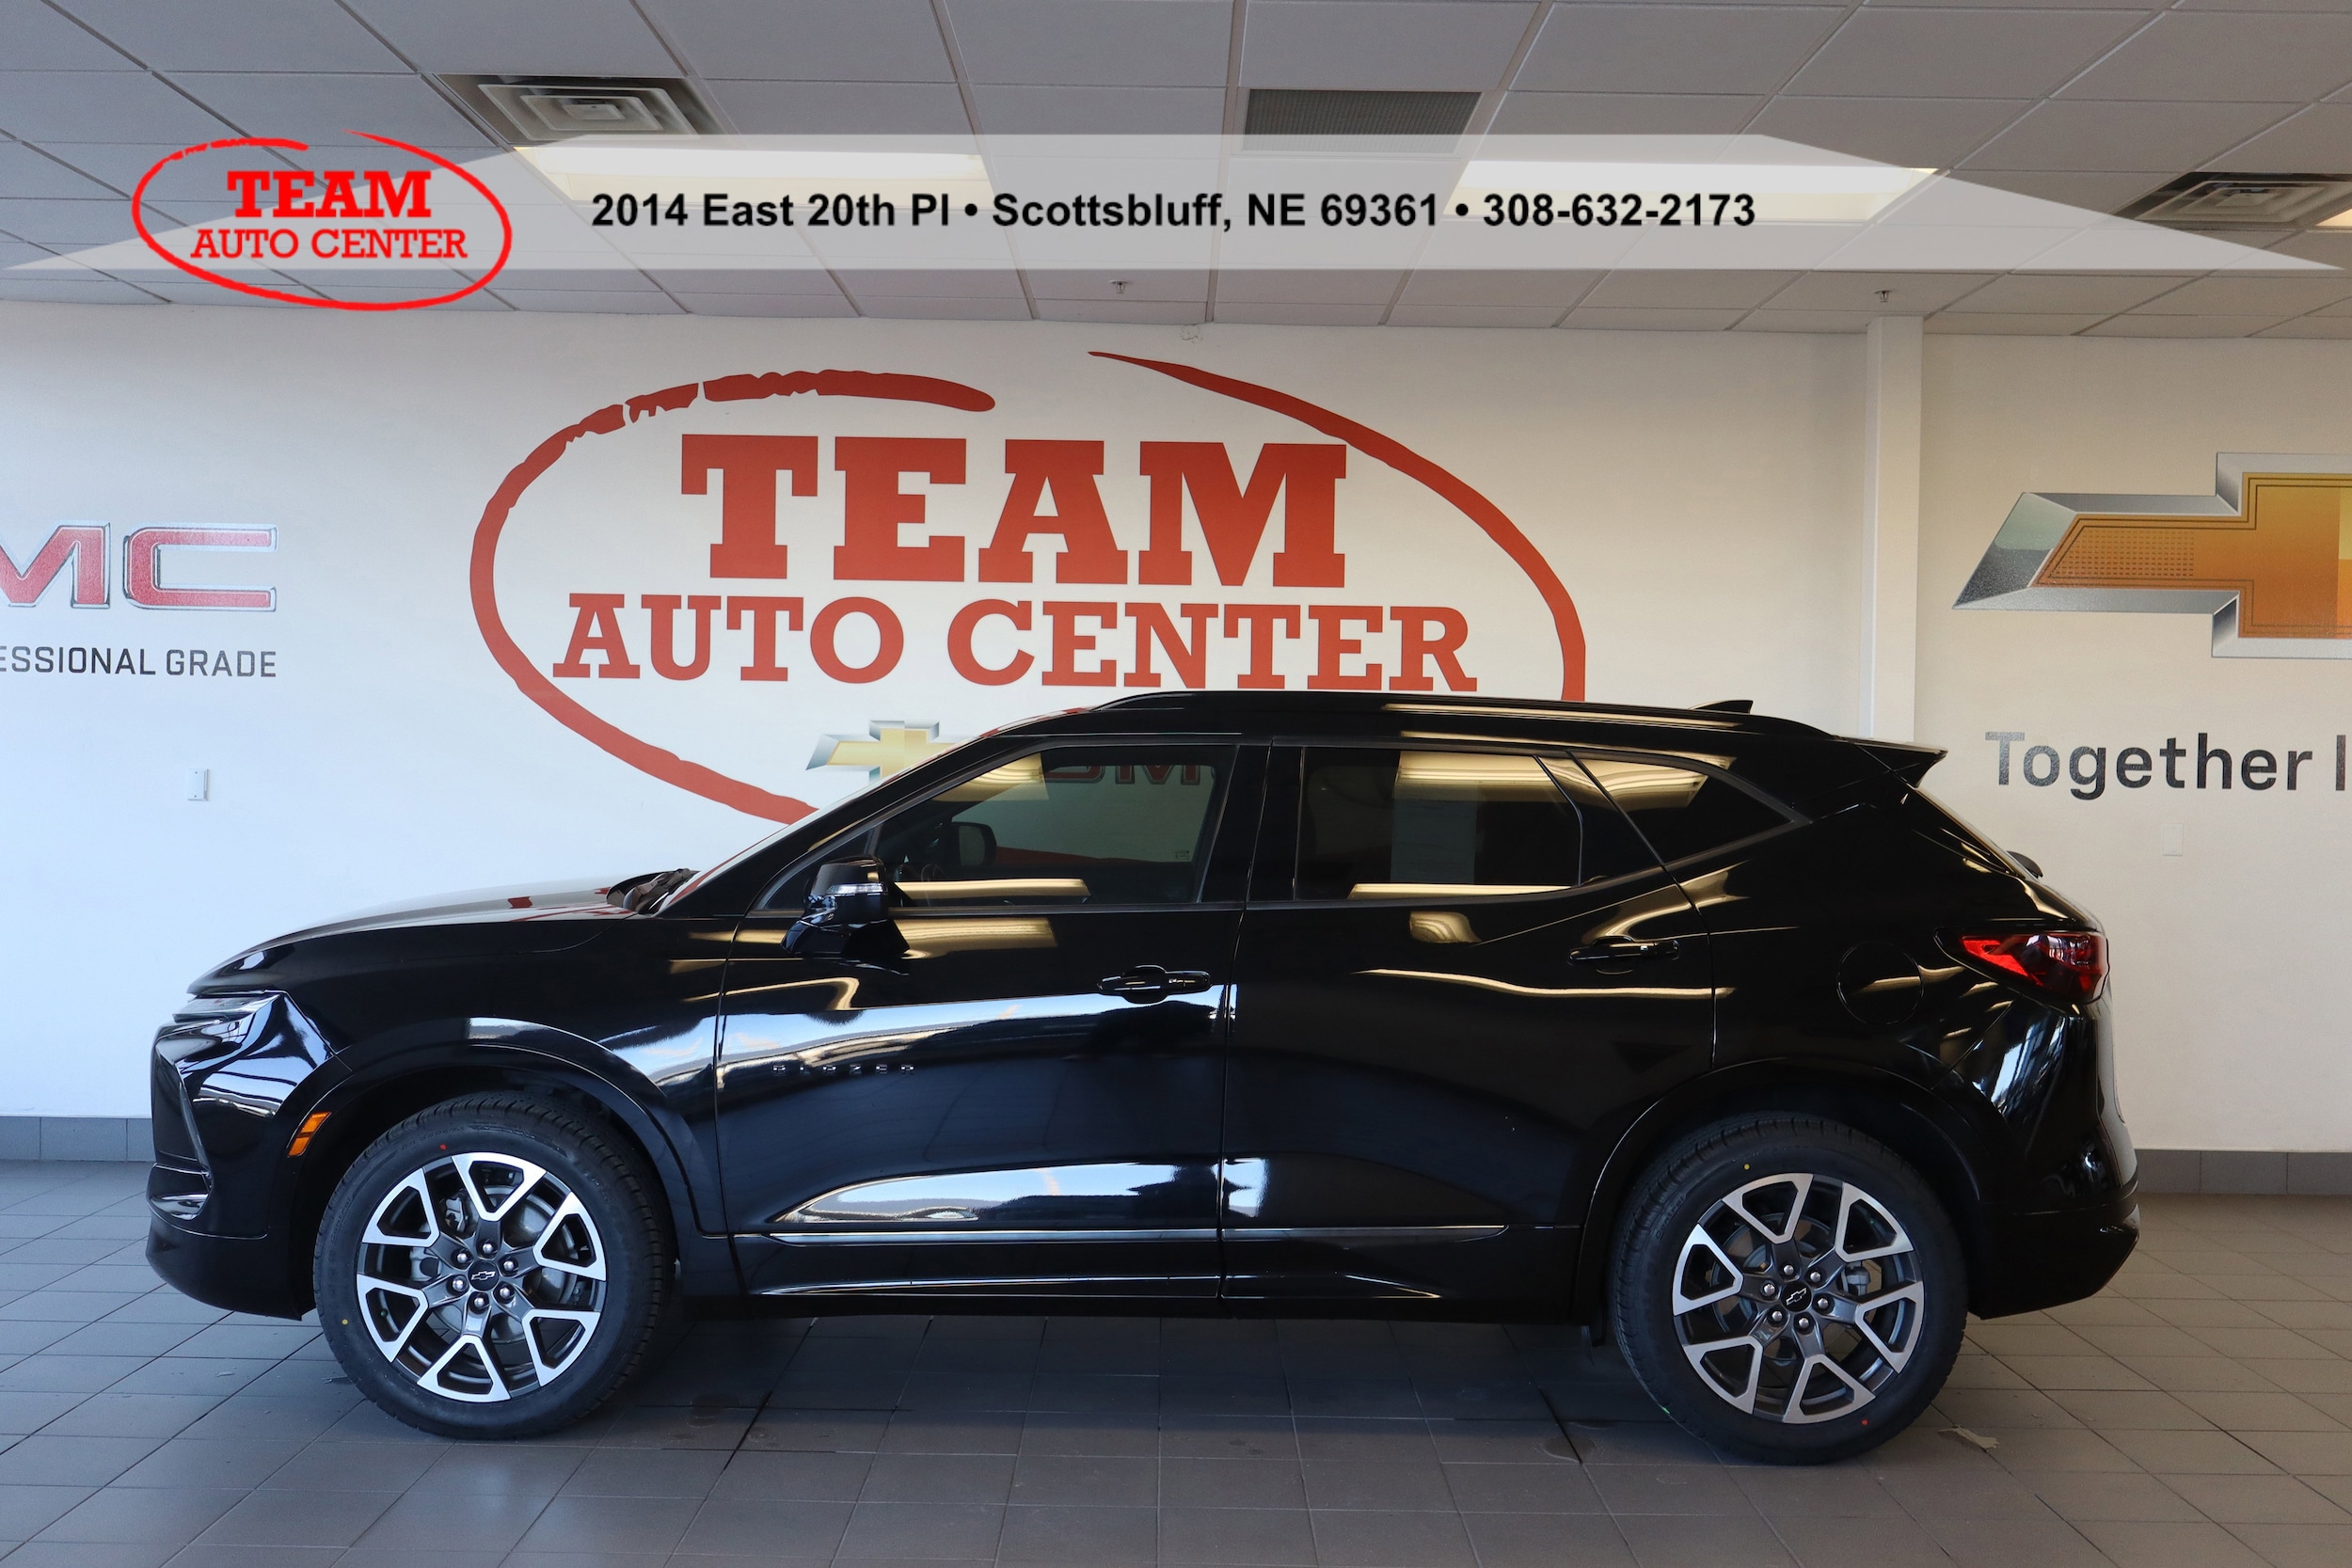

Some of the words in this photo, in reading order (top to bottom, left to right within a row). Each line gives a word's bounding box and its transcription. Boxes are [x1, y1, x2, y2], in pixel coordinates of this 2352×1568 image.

[681, 434, 1347, 588] TEAM
[166, 649, 277, 677] GRADE
[552, 594, 904, 685] AUTO
[946, 598, 1478, 692] CENTER
[1985, 731, 2313, 801] Together
